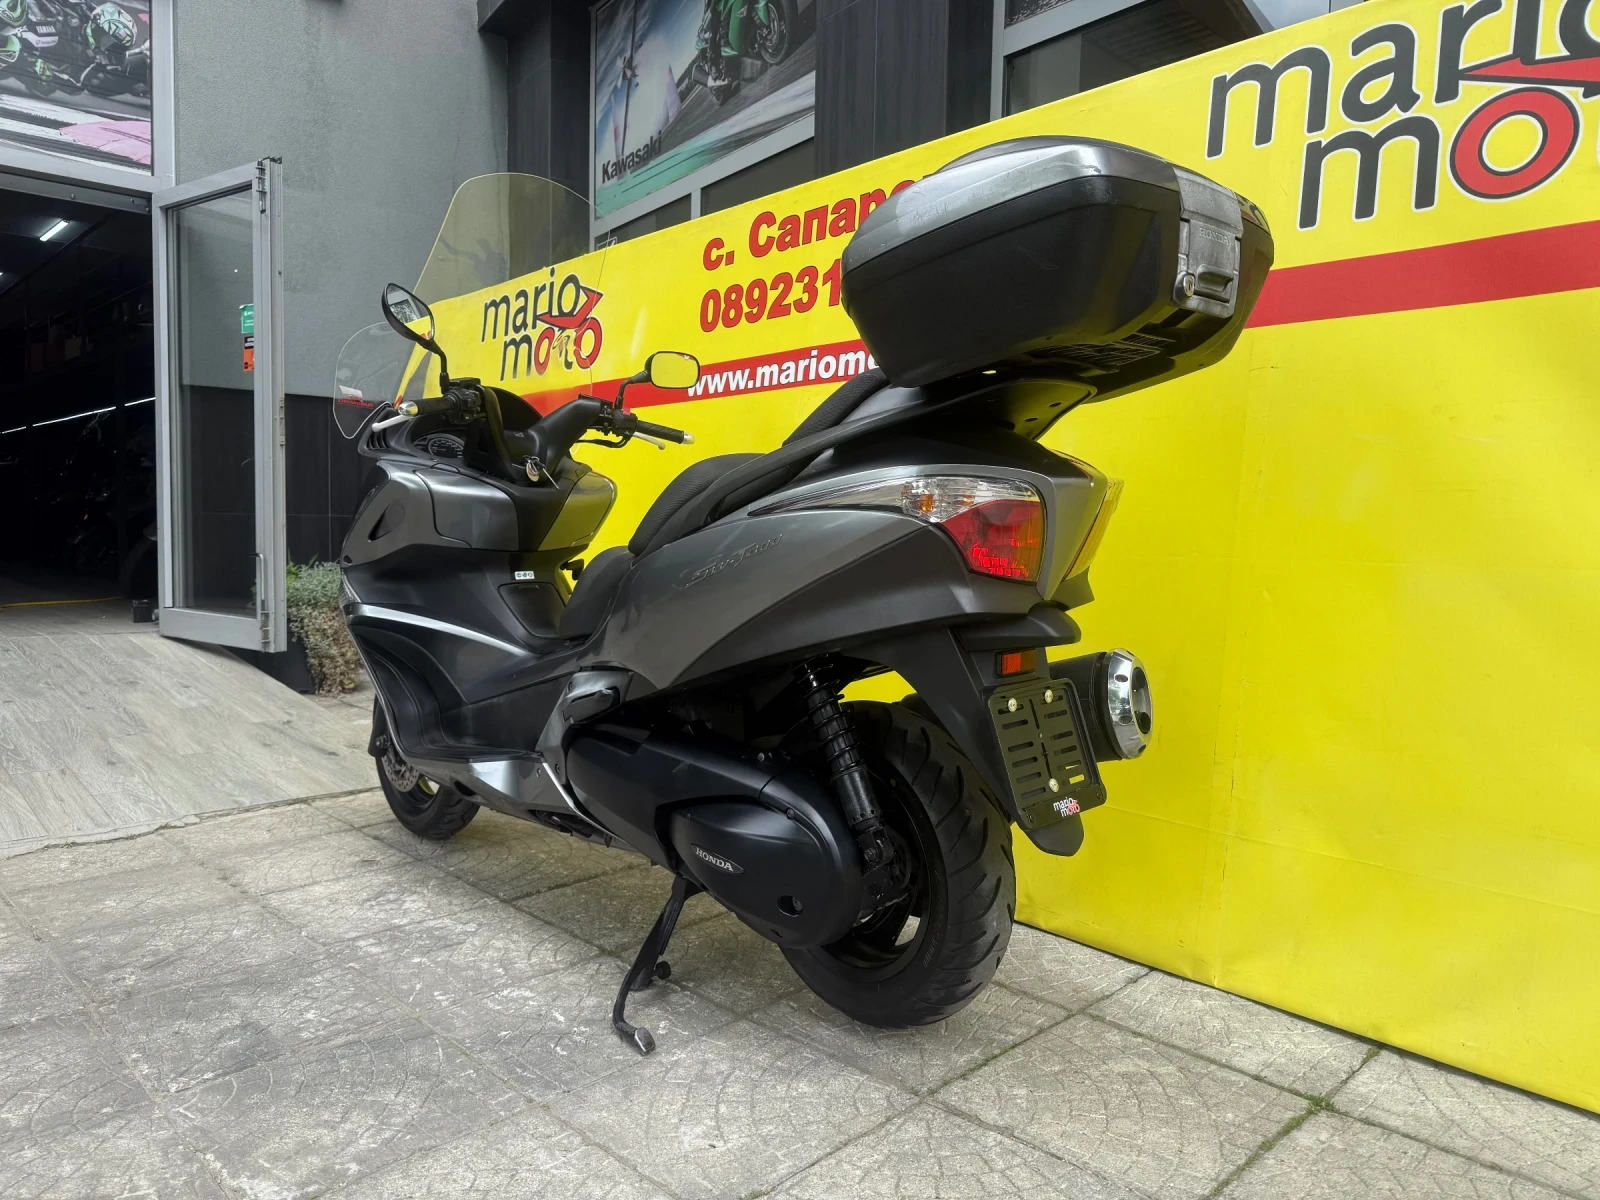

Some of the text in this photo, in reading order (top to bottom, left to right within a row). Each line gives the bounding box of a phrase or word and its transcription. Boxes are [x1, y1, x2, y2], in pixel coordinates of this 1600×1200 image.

[1206, 0, 1600, 158] mari
[602, 129, 661, 184] Kawasaki
[1299, 84, 1600, 229] mo
[1199, 227, 1230, 246] HONDA
[481, 266, 581, 343] mario
[1053, 796, 1074, 811] mario
[1060, 803, 1080, 818] moto
[695, 846, 734, 872] HONDA
